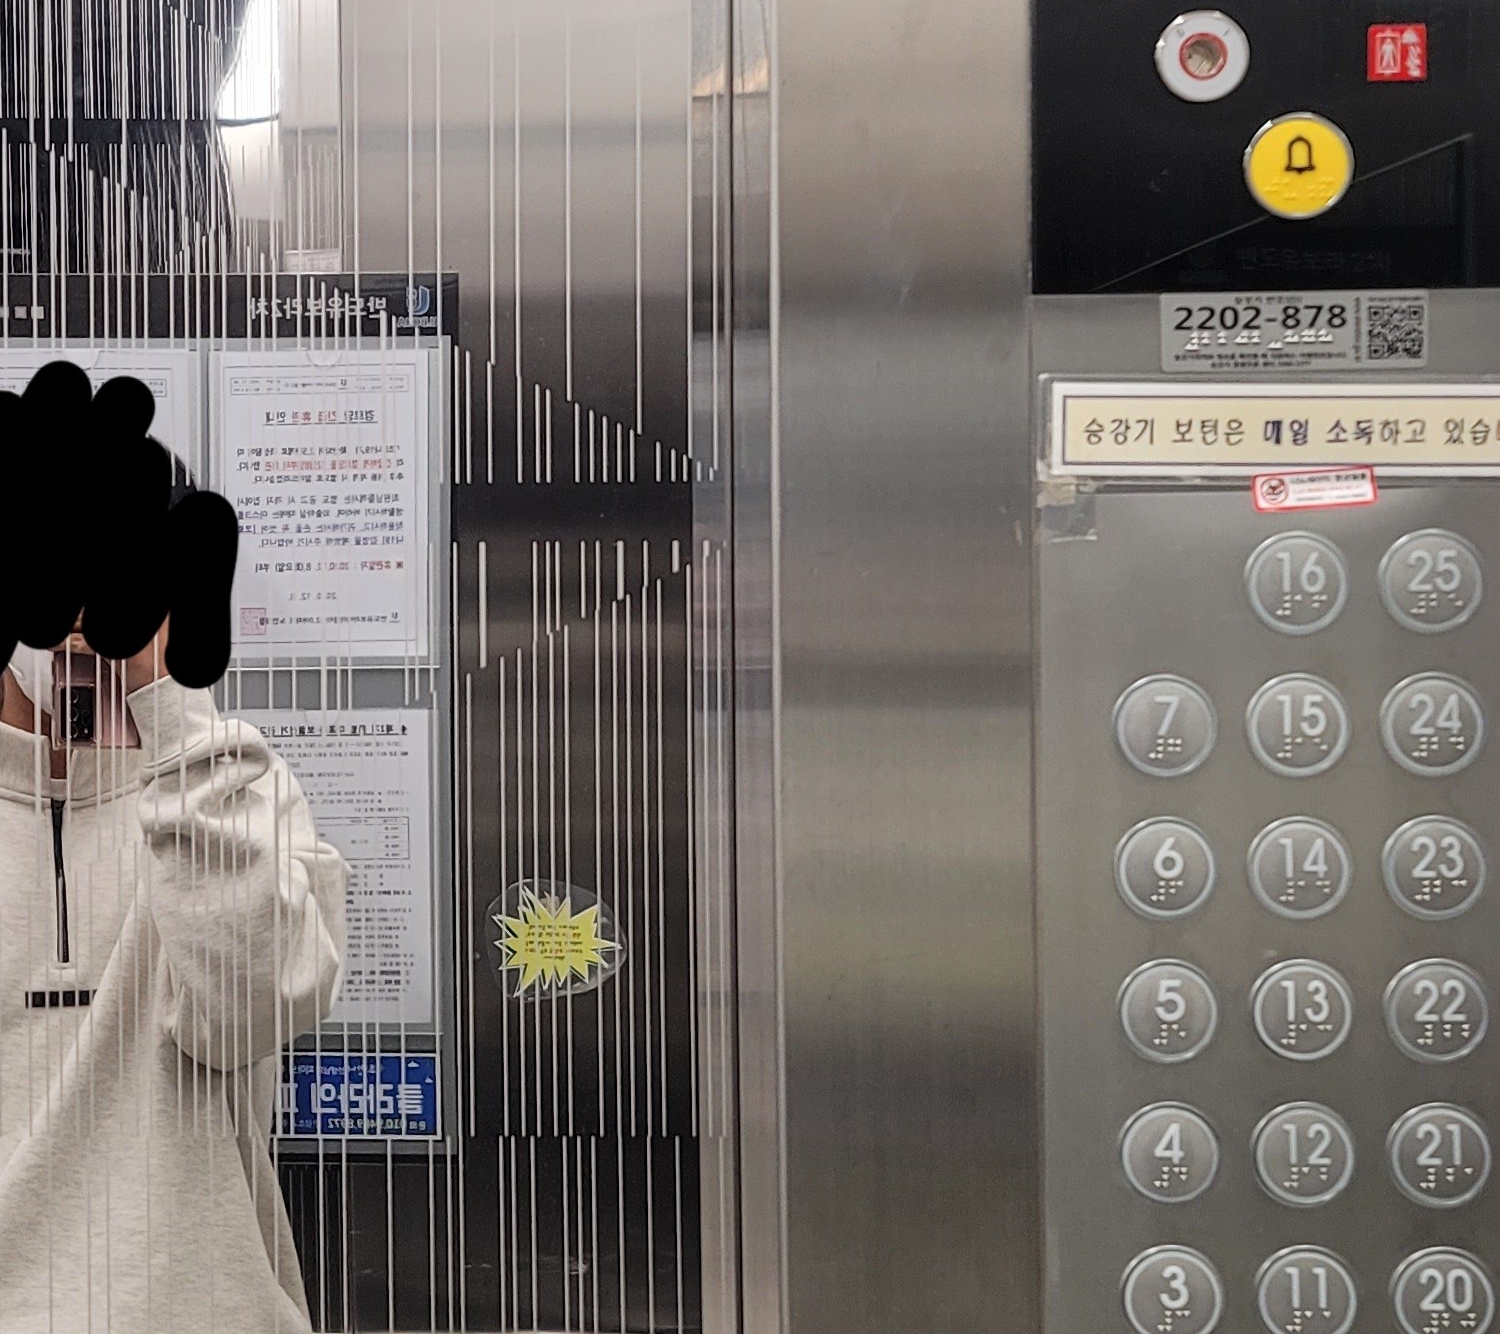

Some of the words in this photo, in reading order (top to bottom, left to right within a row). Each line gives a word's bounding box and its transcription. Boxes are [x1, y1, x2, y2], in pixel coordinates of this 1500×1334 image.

[1174, 305, 1347, 331] 2202-878
[1083, 418, 1157, 445] 승강기
[1263, 418, 1310, 446] 매일
[1326, 418, 1427, 445] 소독하고
[1276, 552, 1325, 593] 16
[1407, 549, 1463, 592] 25
[1154, 695, 1181, 732] 7
[1276, 695, 1327, 737] 15
[1409, 693, 1463, 735] 24
[1153, 837, 1184, 879] 6
[1278, 838, 1328, 879] 14
[1410, 836, 1464, 880] 23
[1155, 979, 1186, 1022] 5
[1281, 980, 1330, 1022] 13
[1414, 980, 1467, 1022] 22
[1153, 1123, 1184, 1165] 4
[1282, 1123, 1332, 1166] 12
[1416, 1123, 1464, 1167] 21
[1159, 1265, 1189, 1310] 3
[1284, 1266, 1328, 1310] 11
[1419, 1268, 1472, 1312] 20
